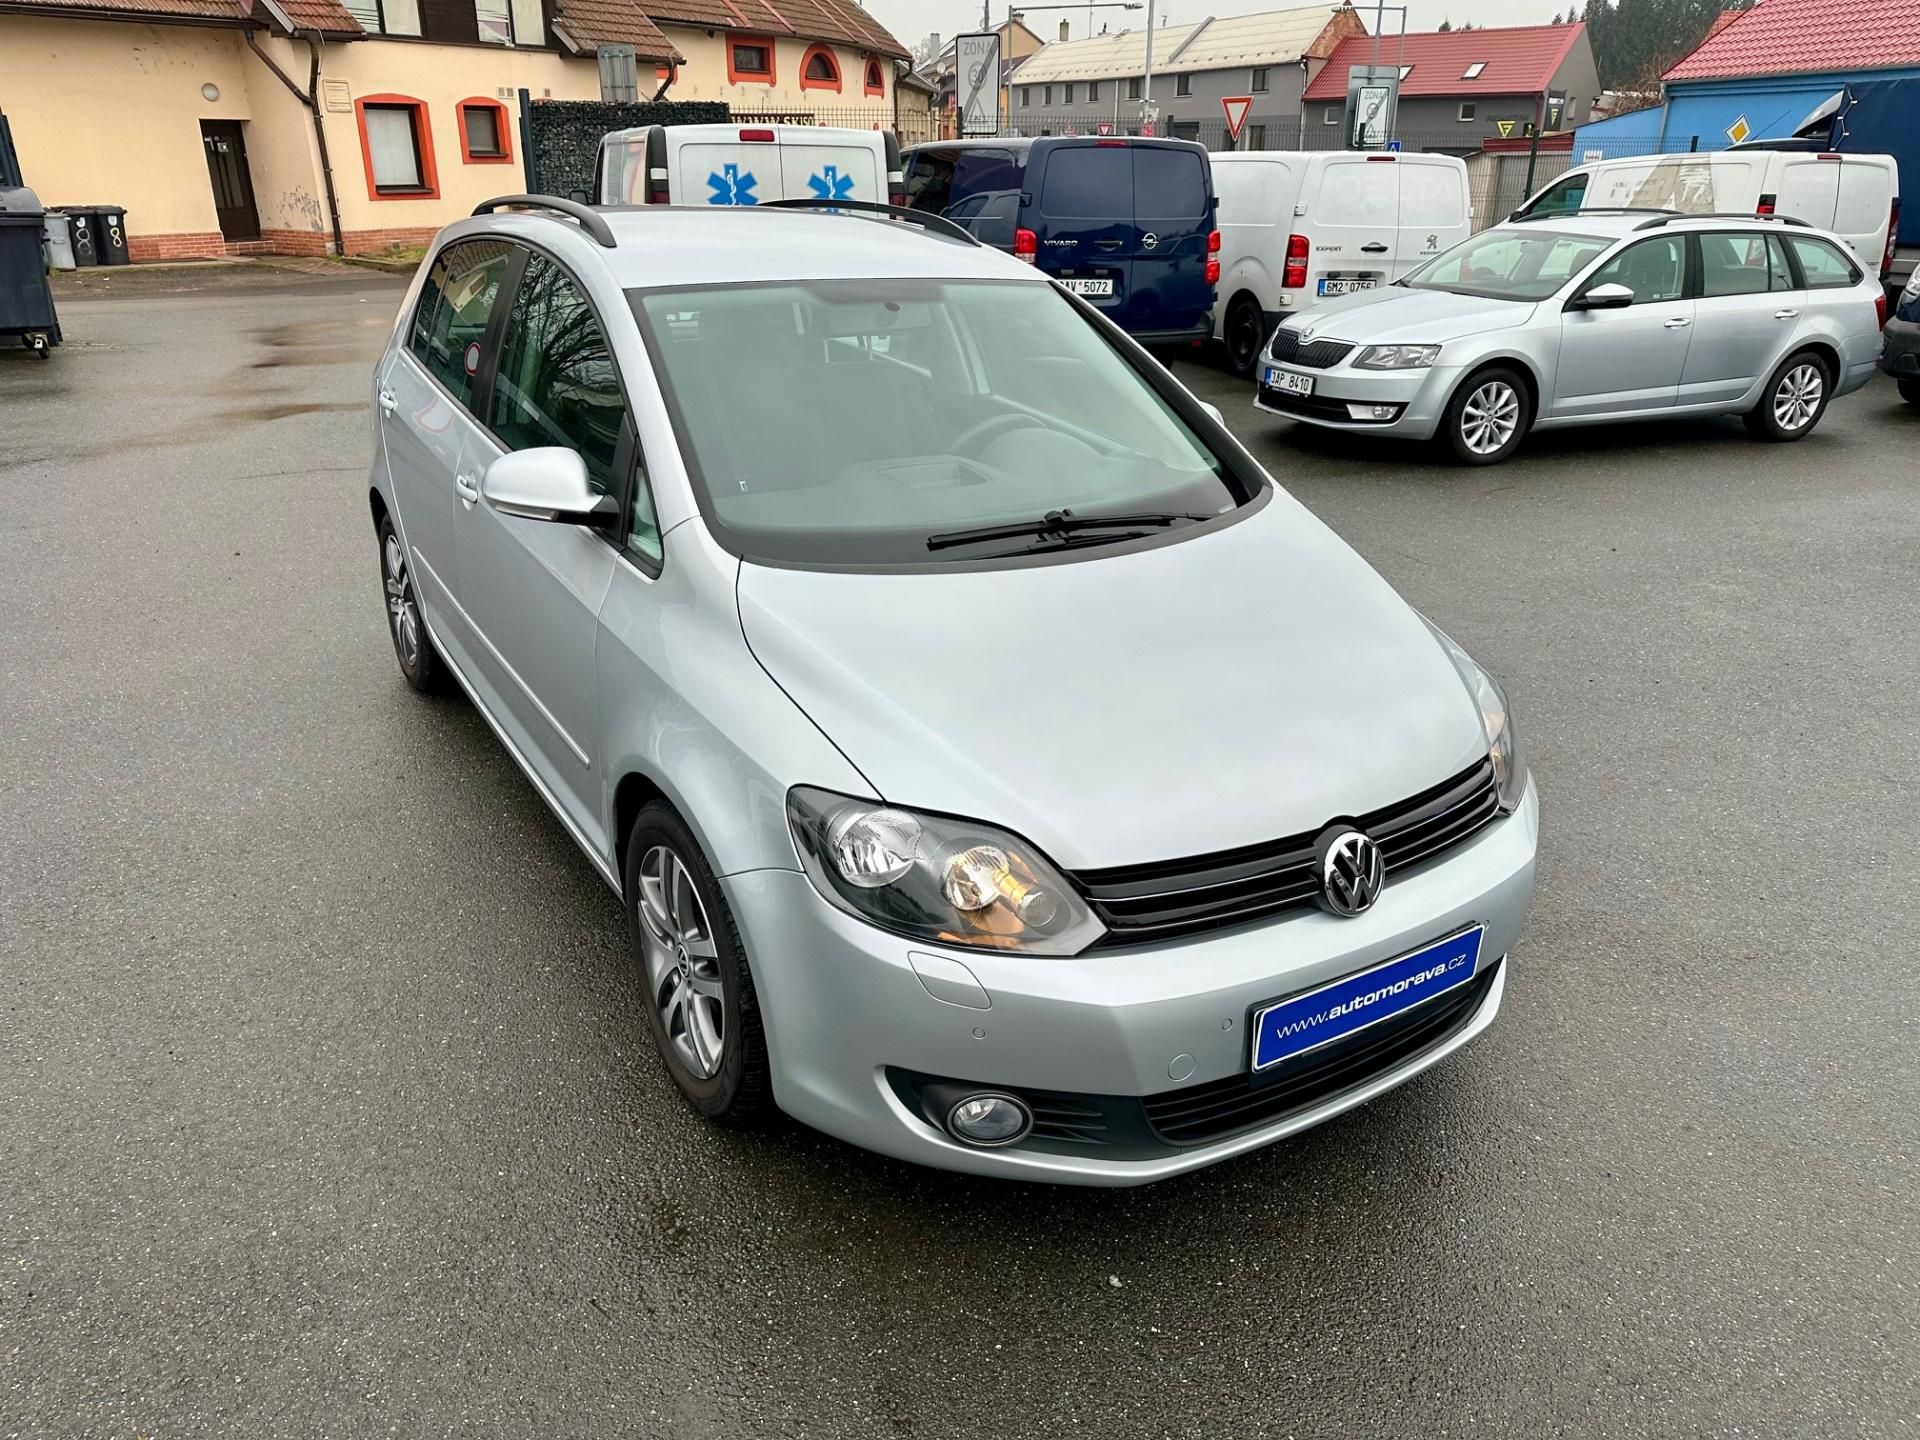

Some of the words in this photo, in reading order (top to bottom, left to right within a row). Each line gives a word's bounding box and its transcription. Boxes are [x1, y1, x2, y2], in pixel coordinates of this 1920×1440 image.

[1084, 281, 1108, 293] 5072
[1326, 281, 1344, 293] 6M2
[1271, 371, 1285, 386] 3AP
[1288, 375, 1310, 392] 8410
[1276, 953, 1467, 1039] www.automorava.cz
